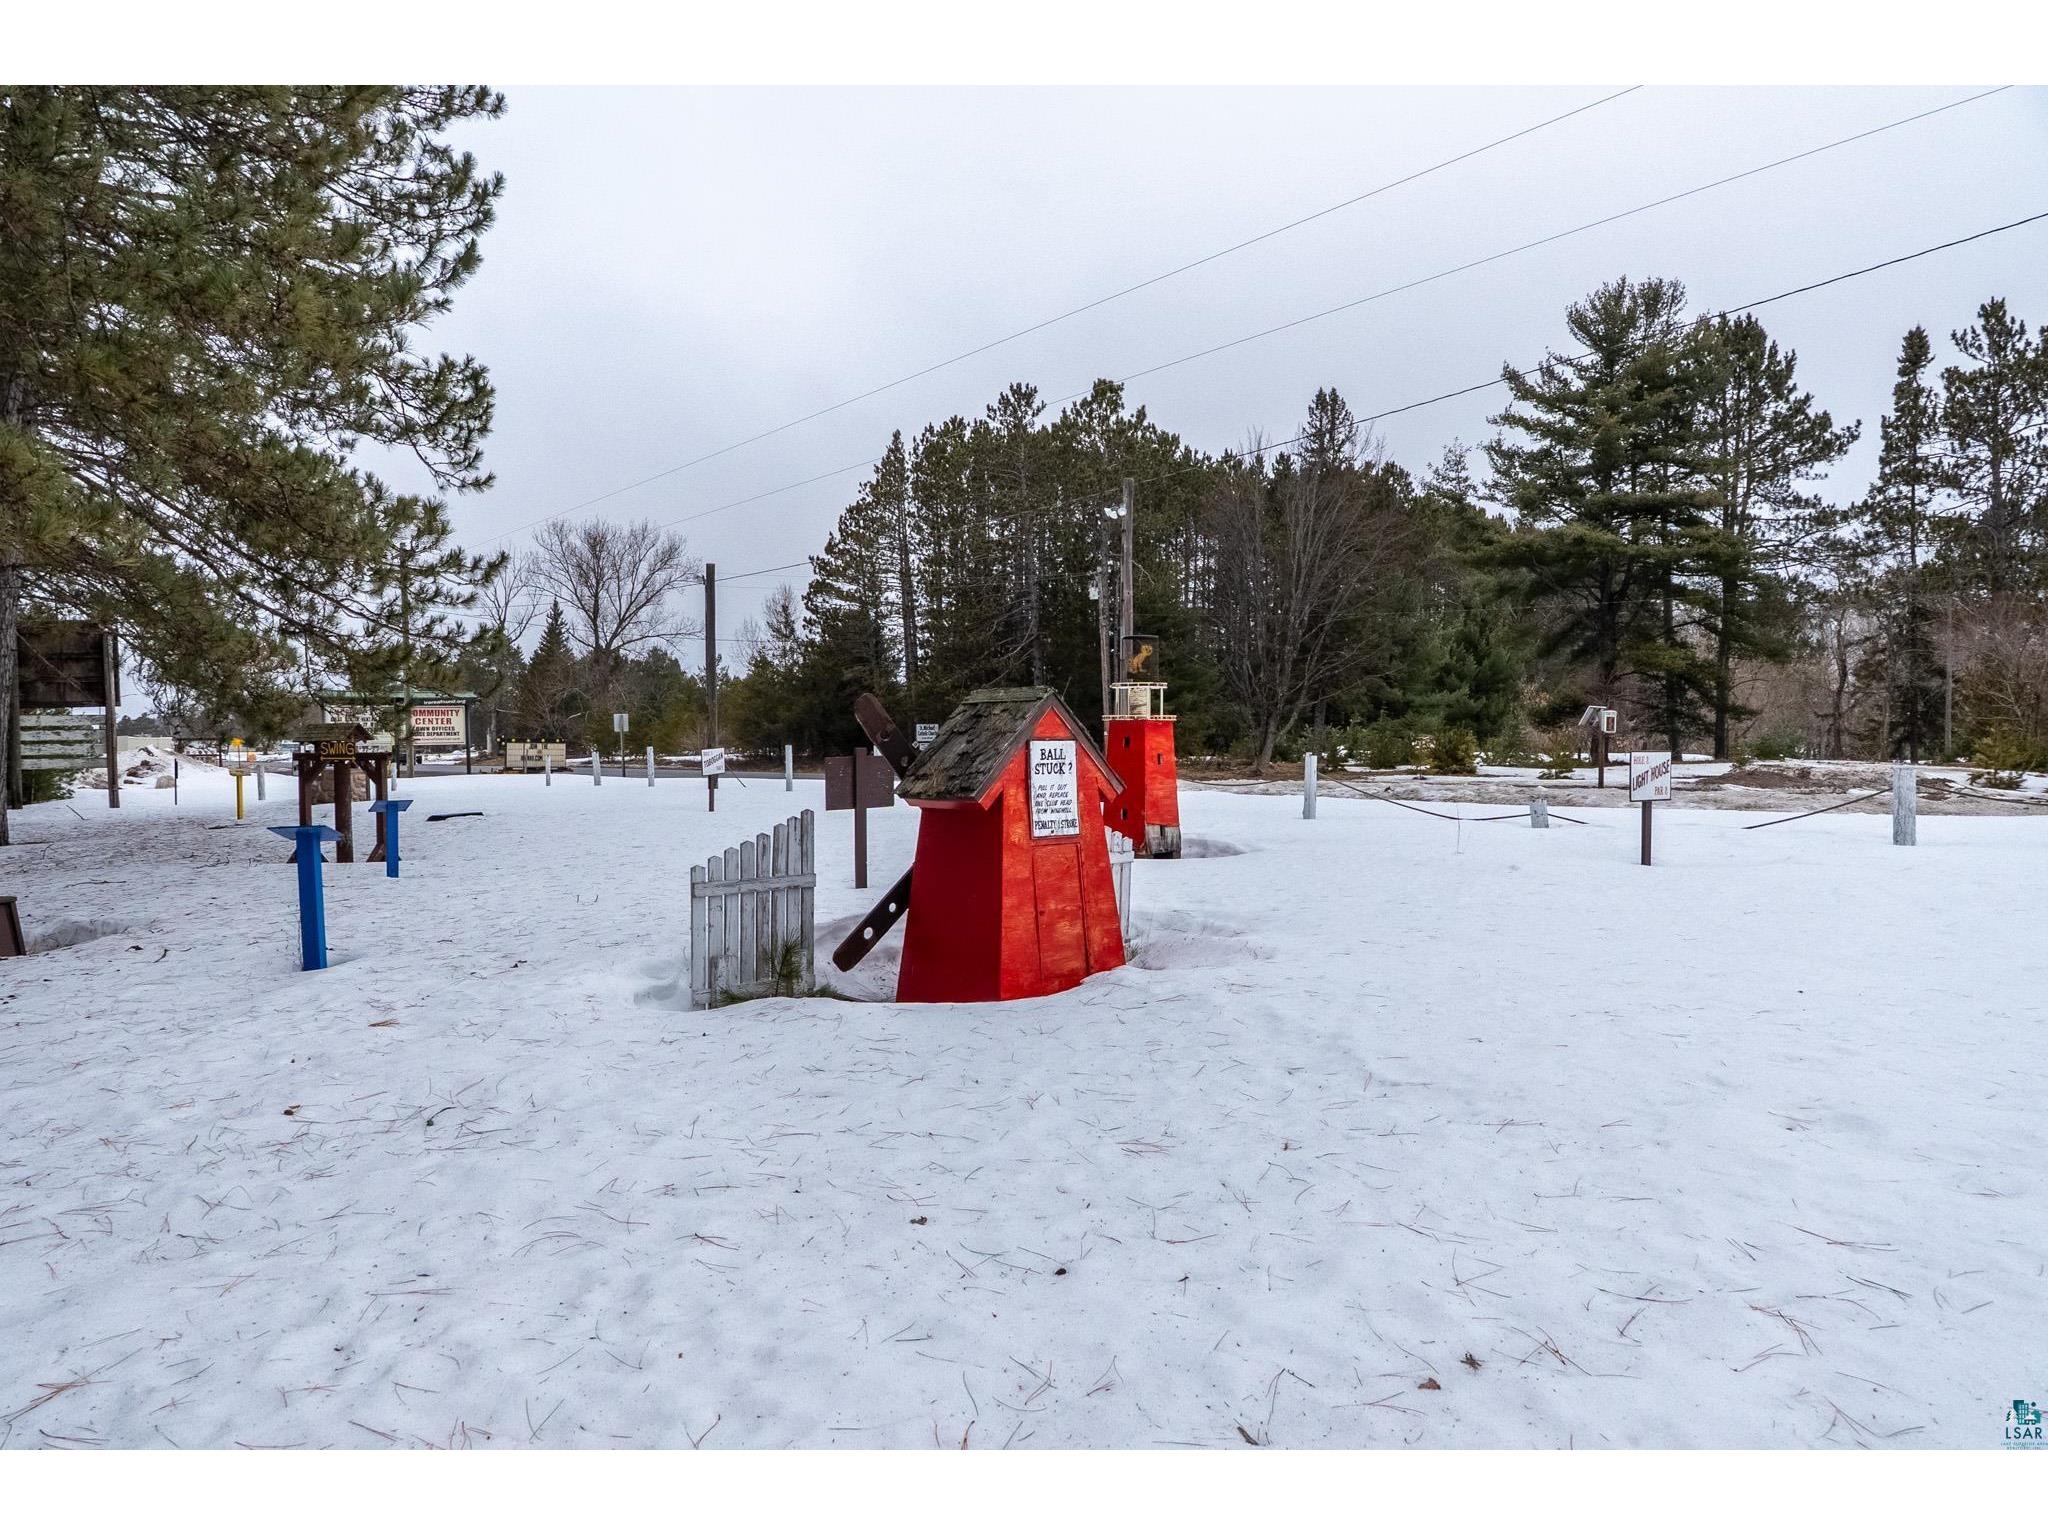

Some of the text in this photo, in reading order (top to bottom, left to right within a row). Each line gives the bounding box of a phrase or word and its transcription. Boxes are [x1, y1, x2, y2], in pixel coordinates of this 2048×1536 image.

[411, 709, 460, 717] OMMUNITY
[415, 717, 452, 725] CENTER
[320, 741, 355, 756] SWING
[1040, 749, 1066, 760] BALL
[1034, 762, 1067, 775] STUCK
[1632, 759, 1670, 791] LIGHT HOUSE
[1654, 785, 1664, 796] PAR
[1034, 819, 1056, 831] PENALTY
